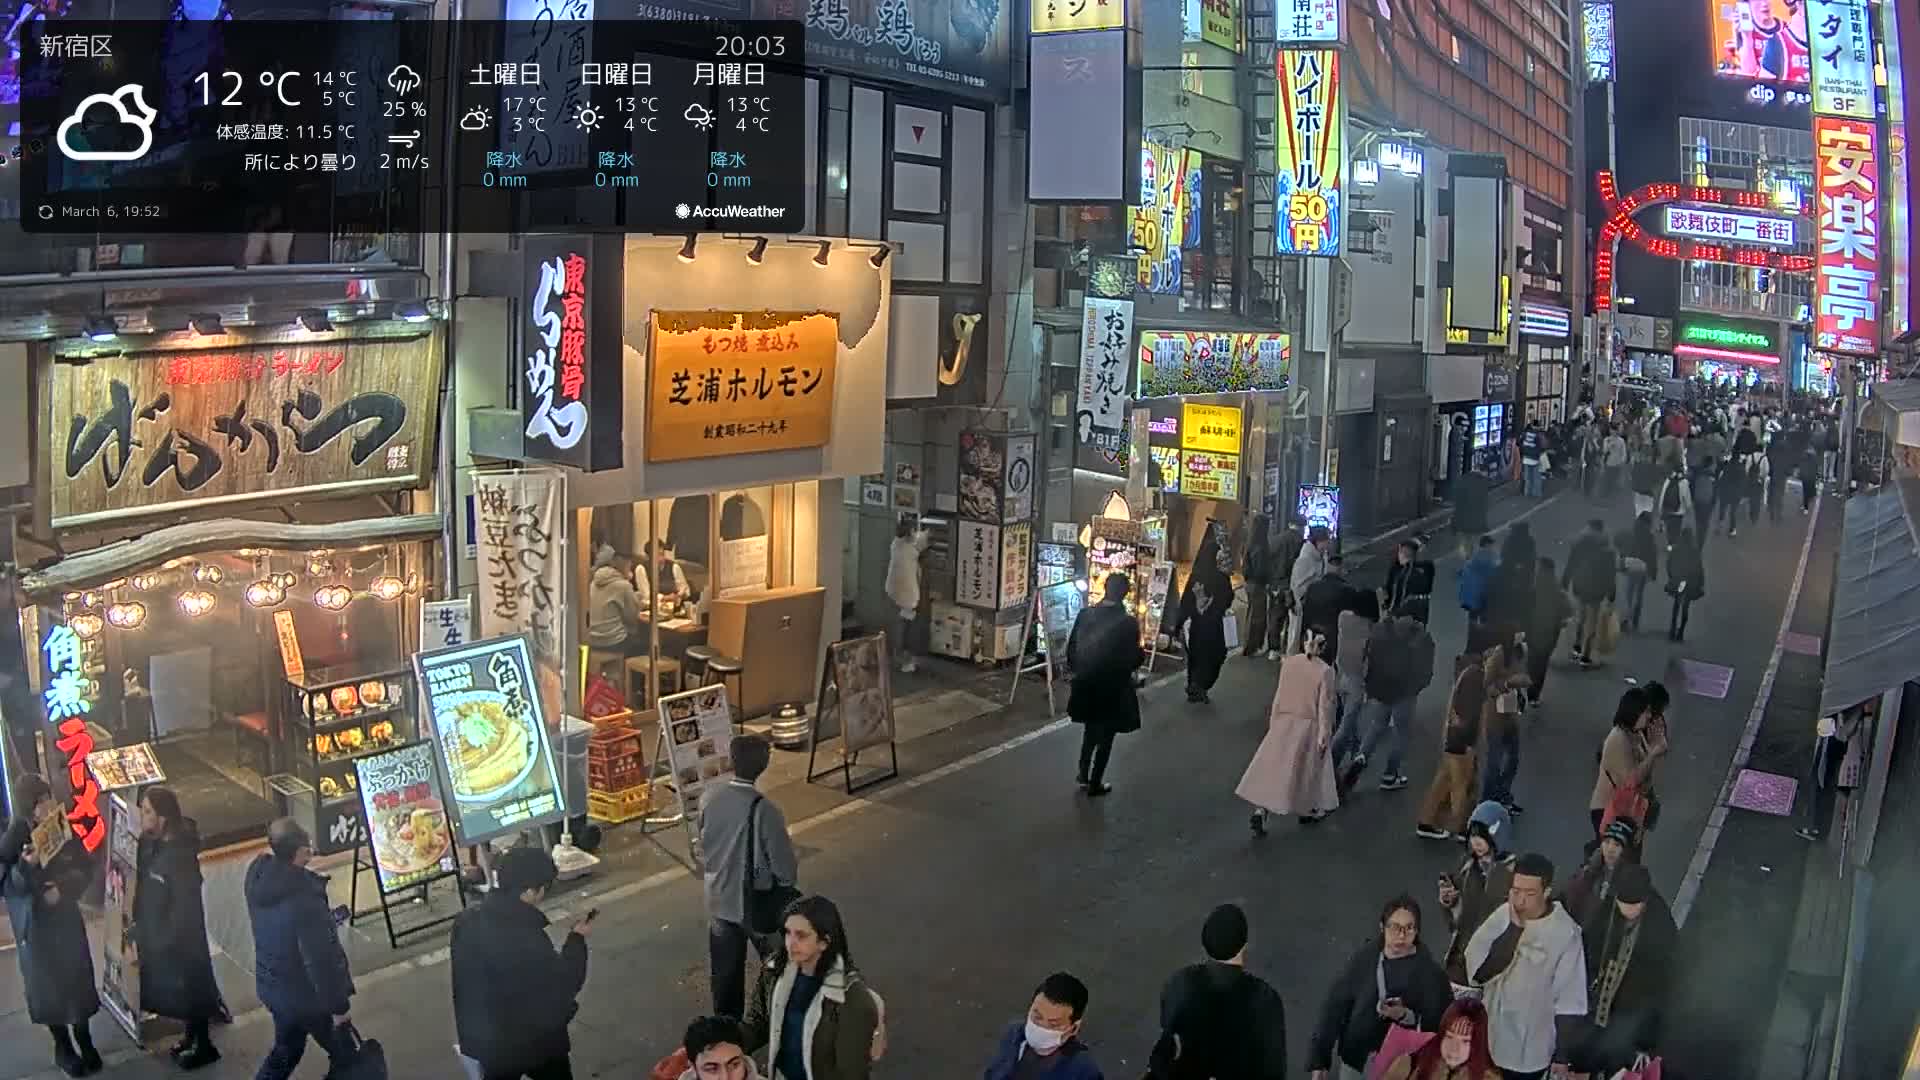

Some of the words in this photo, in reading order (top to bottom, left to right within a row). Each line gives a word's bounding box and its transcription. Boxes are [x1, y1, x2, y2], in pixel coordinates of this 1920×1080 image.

[1750, 84, 1775, 103] dip
[1832, 97, 1857, 111] 3F
[1294, 54, 1322, 190] ハイボール
[1671, 211, 1789, 241] 歌舞伎町一番街
[1818, 127, 1876, 330] 安楽亭
[560, 252, 588, 401] 東京豚骨
[702, 333, 748, 354] もつ焼
[1818, 332, 1836, 348] 2F
[1096, 309, 1128, 415] お好み焼き
[668, 367, 823, 406] 芝浦ホルモン
[65, 378, 407, 491] ばんから
